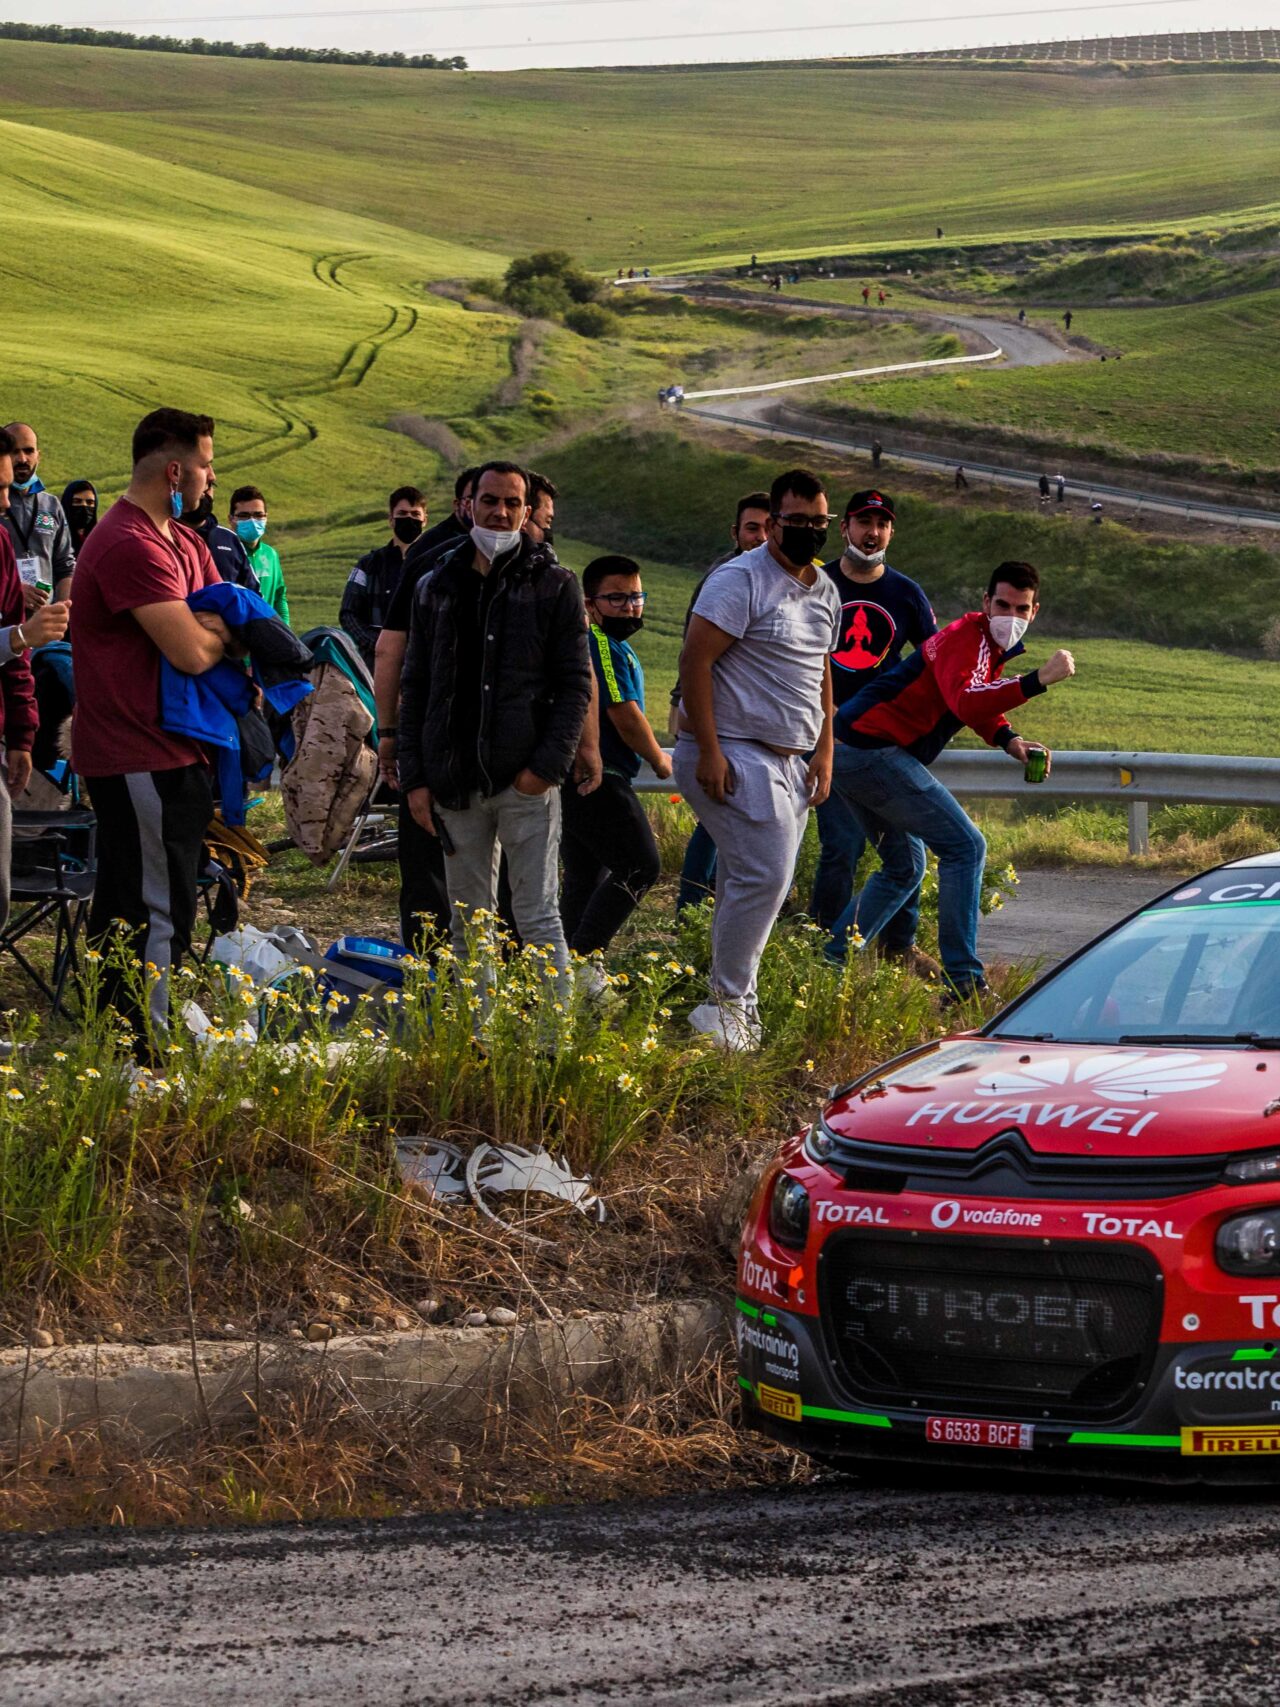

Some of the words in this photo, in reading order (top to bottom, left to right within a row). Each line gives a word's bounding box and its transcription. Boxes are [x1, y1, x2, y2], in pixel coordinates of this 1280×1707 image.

[905, 1102, 1160, 1137] HUAWEI
[815, 1201, 890, 1224] TOTAL
[963, 1208, 1042, 1228] vodafone
[1083, 1212, 1184, 1240] TOTAL
[742, 1250, 788, 1303] TOTAL
[761, 1387, 796, 1417] PIRELLI
[932, 1420, 942, 1440] S
[945, 1421, 980, 1442] 6533
[988, 1424, 1017, 1445] BCF
